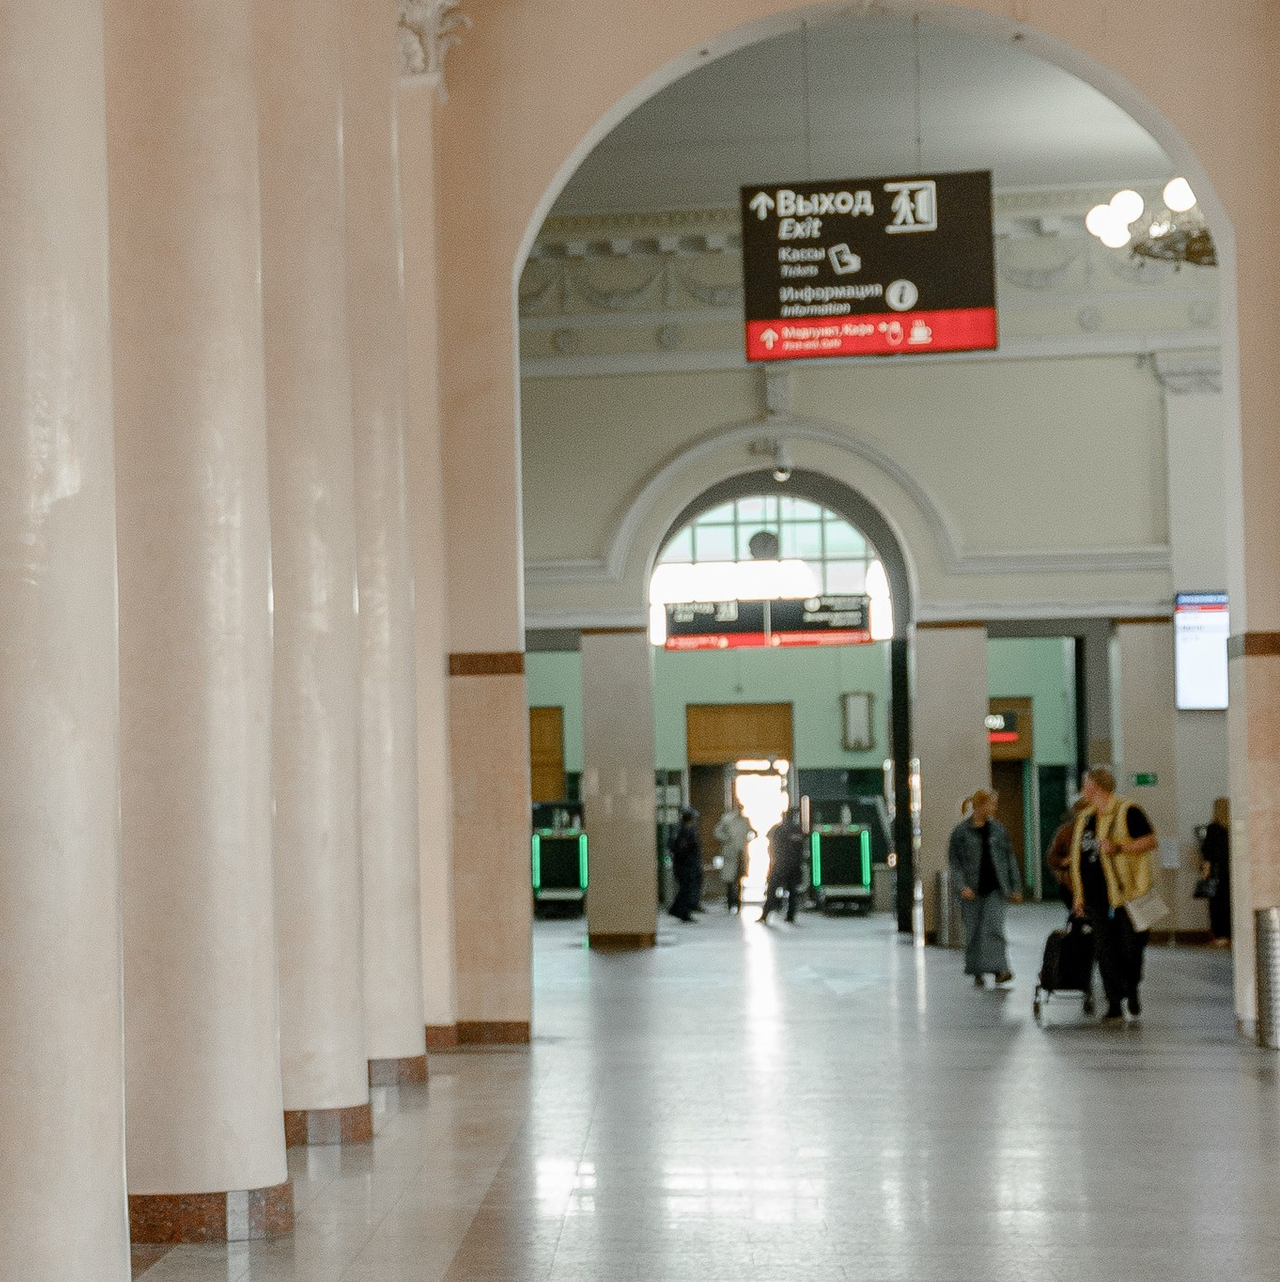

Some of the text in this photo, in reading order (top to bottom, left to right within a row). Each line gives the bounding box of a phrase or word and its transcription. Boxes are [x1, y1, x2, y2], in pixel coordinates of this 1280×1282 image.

[776, 189, 875, 217] Выход
[778, 217, 823, 240] Exit
[778, 246, 826, 263] Кассы
[778, 283, 883, 304] Информация
[780, 302, 851, 318] Information
